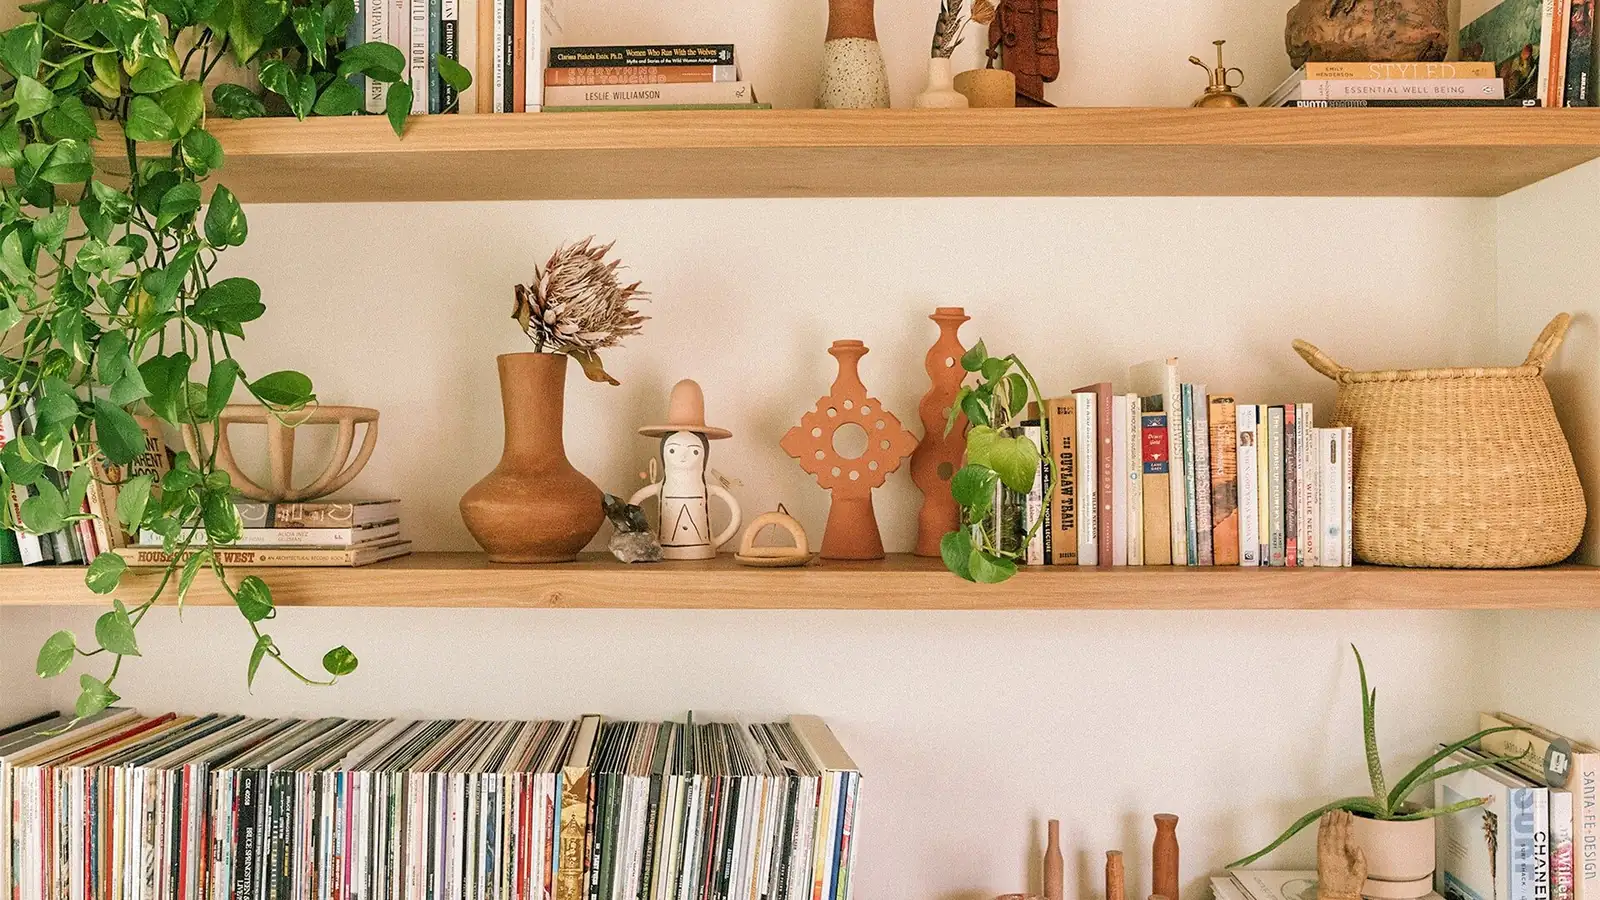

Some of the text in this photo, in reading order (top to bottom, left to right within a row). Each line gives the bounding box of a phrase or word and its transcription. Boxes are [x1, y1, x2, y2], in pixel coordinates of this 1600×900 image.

[413, 43, 425, 70] HOME
[557, 53, 577, 65] Clarissa
[577, 53, 595, 64] Pinkola
[610, 52, 624, 64] Ph.D.
[626, 49, 646, 57] Women
[647, 49, 661, 57] Who
[673, 48, 687, 56] With
[688, 48, 696, 56] the
[696, 48, 717, 56] Wolves
[567, 67, 658, 76] EVERYTHING
[567, 74, 667, 85] SHE TOUCHED
[1369, 63, 1456, 80] STYLED
[585, 90, 661, 101] LESLIE WILLIAMSON
[1344, 86, 1465, 94] ESSENTIAL WELL BEING
[1579, 72, 1587, 100] ABRAMS
[1172, 394, 1184, 461] SOUTHWEST
[1060, 437, 1075, 531] THE OUTLAW TRAIL
[1194, 420, 1212, 532] Enjoying the Southwest
[1273, 472, 1280, 481] OF
[224, 552, 255, 563] WEST
[1583, 771, 1597, 880] SANTA FE DESIGN
[245, 827, 253, 849] BRUCE
[243, 849, 252, 895] SPRINGSTEEN
[1534, 831, 1547, 900] CHANE
